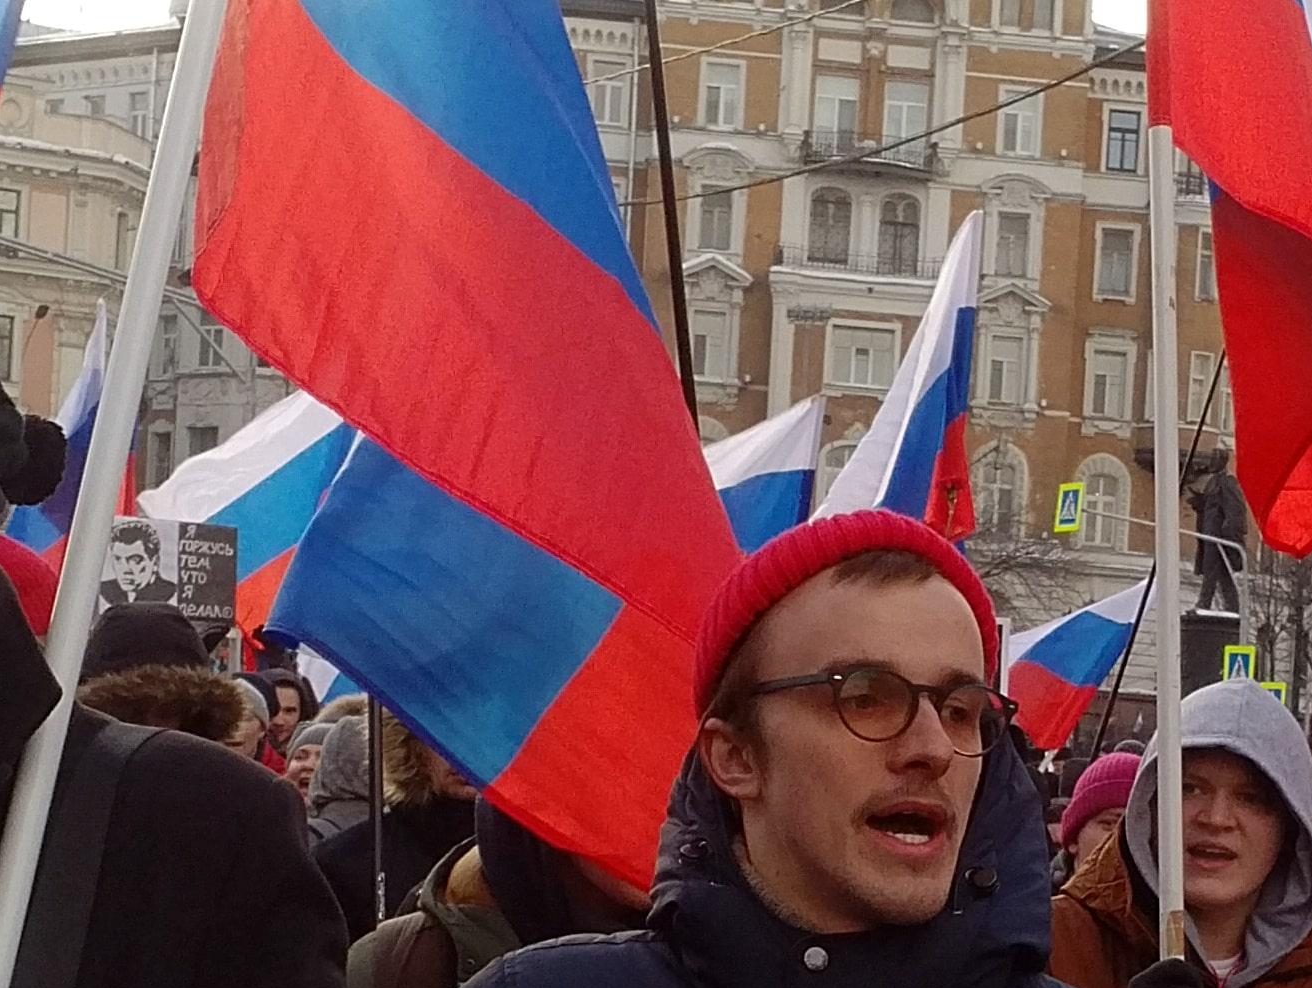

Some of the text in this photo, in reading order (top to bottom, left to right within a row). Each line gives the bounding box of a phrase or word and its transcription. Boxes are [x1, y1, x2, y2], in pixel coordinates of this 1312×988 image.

[185, 525, 198, 538] Я
[179, 539, 234, 556] ГОРЖУСЬ
[181, 570, 208, 585] ЧТО
[182, 585, 194, 599] Я
